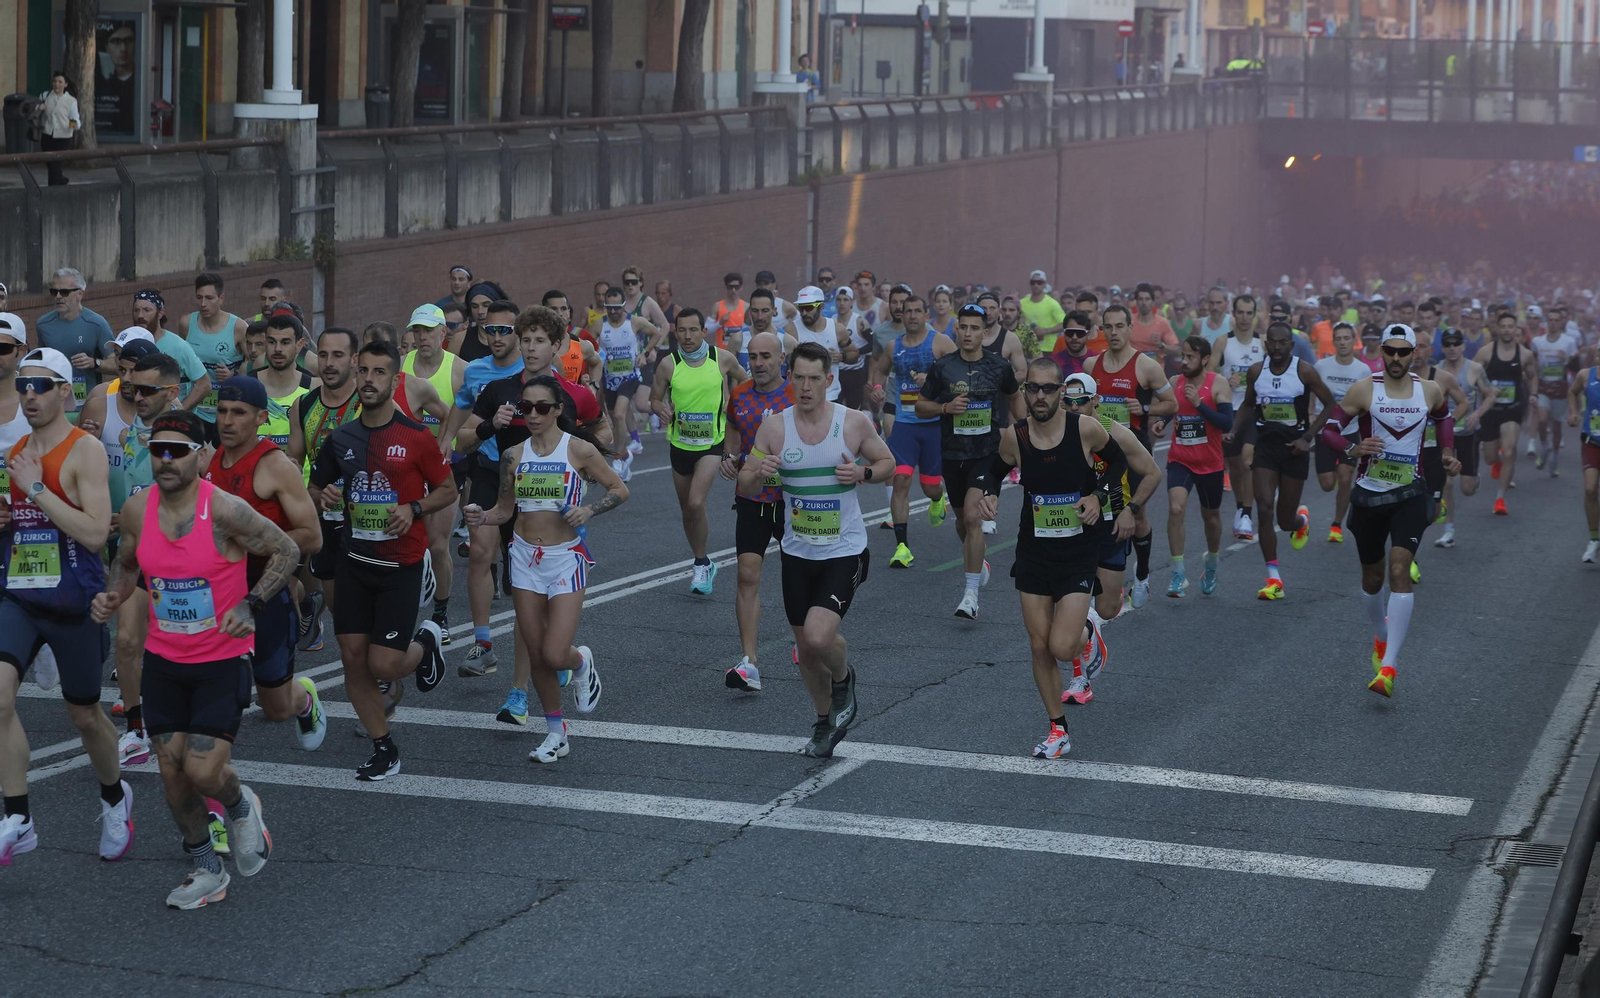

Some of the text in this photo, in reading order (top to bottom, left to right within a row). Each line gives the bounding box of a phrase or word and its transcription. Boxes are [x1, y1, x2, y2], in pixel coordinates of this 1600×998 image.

[681, 430, 709, 438] NICOLAS
[1379, 470, 1402, 482] SAMY
[518, 487, 560, 497] SUZANNE
[1045, 518, 1070, 527] LARO
[792, 524, 817, 534] MADDY'S
[22, 533, 51, 542] ZURICH
[18, 559, 48, 574] MARTÍ
[167, 580, 201, 590] ZURICH
[170, 598, 189, 606] 5456
[167, 608, 198, 620] FRAN
